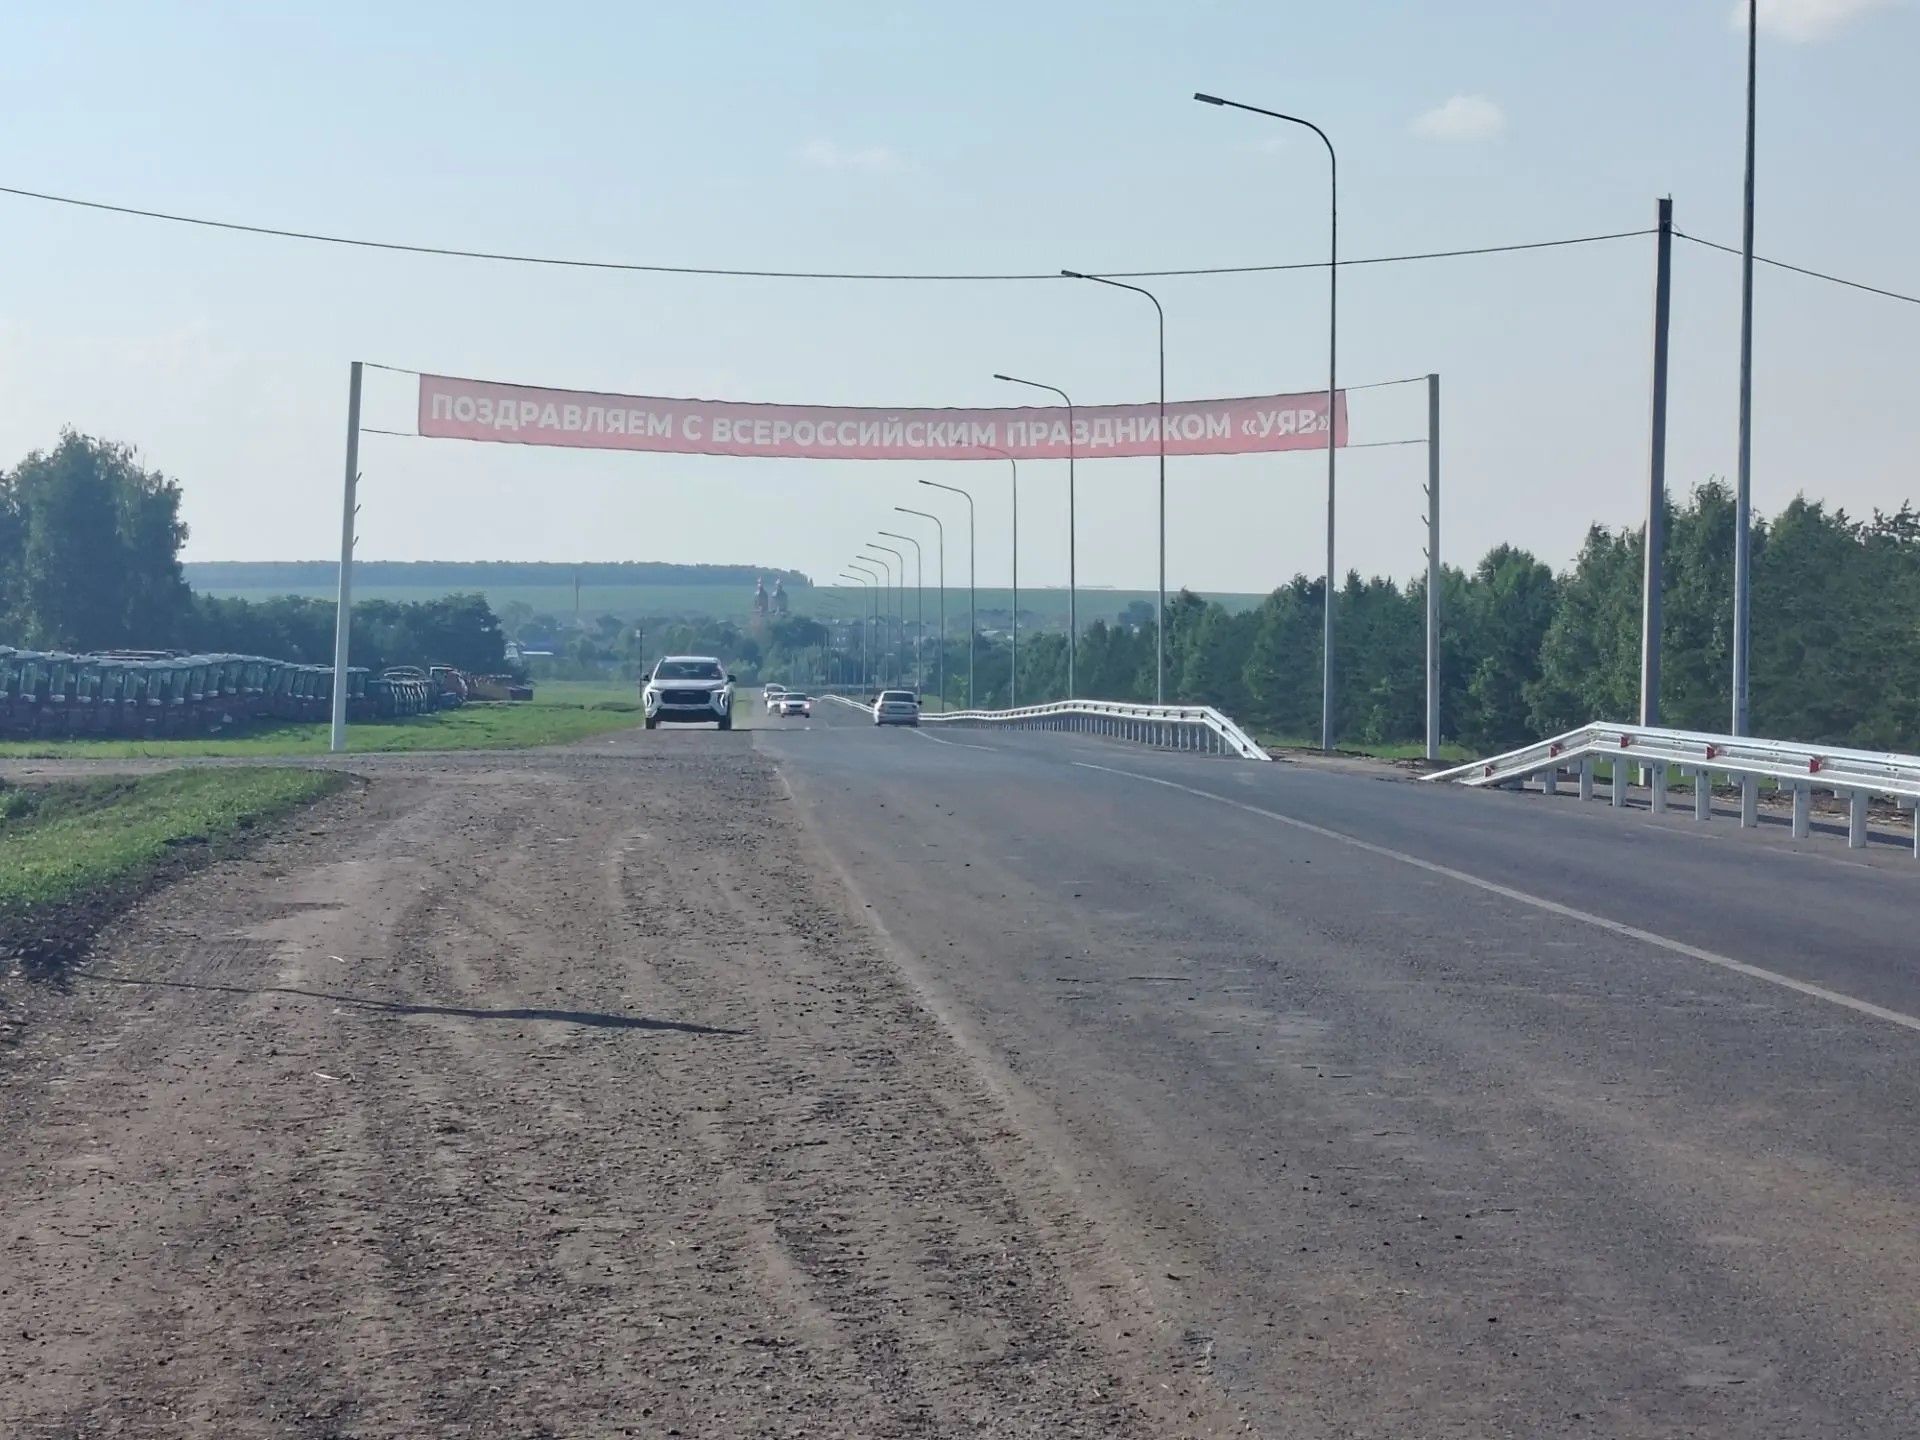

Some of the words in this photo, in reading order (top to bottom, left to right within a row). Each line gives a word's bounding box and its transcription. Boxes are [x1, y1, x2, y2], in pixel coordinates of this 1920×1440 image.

[431, 393, 672, 438] ПОЗДРАВЛЯЕМ
[681, 415, 702, 441] С
[711, 416, 996, 448] ВСЕРОССИЙСКИМ
[1006, 413, 1231, 448] ПРАЗДНИКОМ
